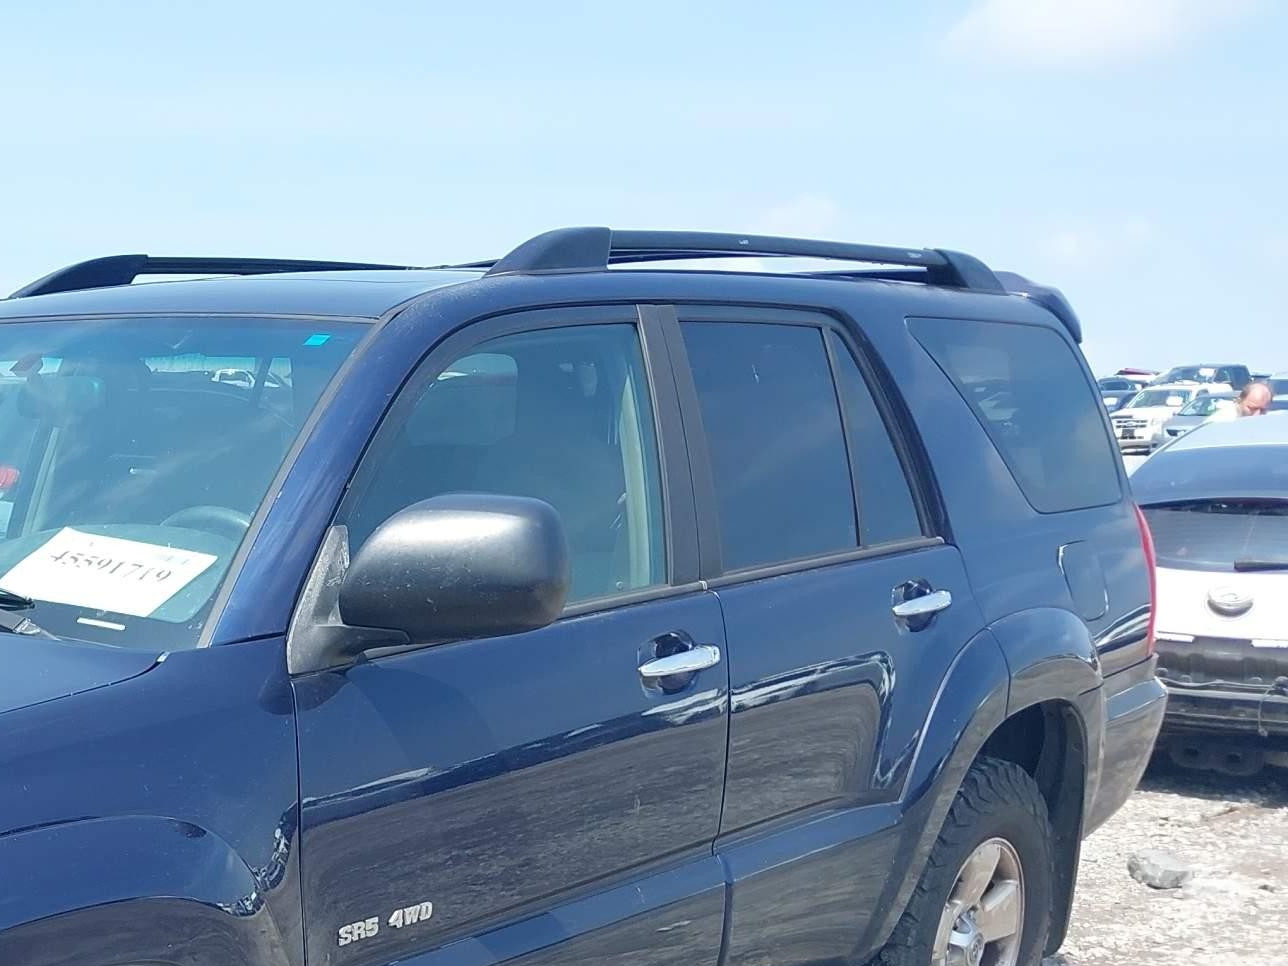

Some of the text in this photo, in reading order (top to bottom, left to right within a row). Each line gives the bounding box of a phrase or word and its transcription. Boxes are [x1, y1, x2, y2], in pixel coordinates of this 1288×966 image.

[48, 549, 173, 583] 45591719
[338, 901, 433, 947] SR5 4WD
